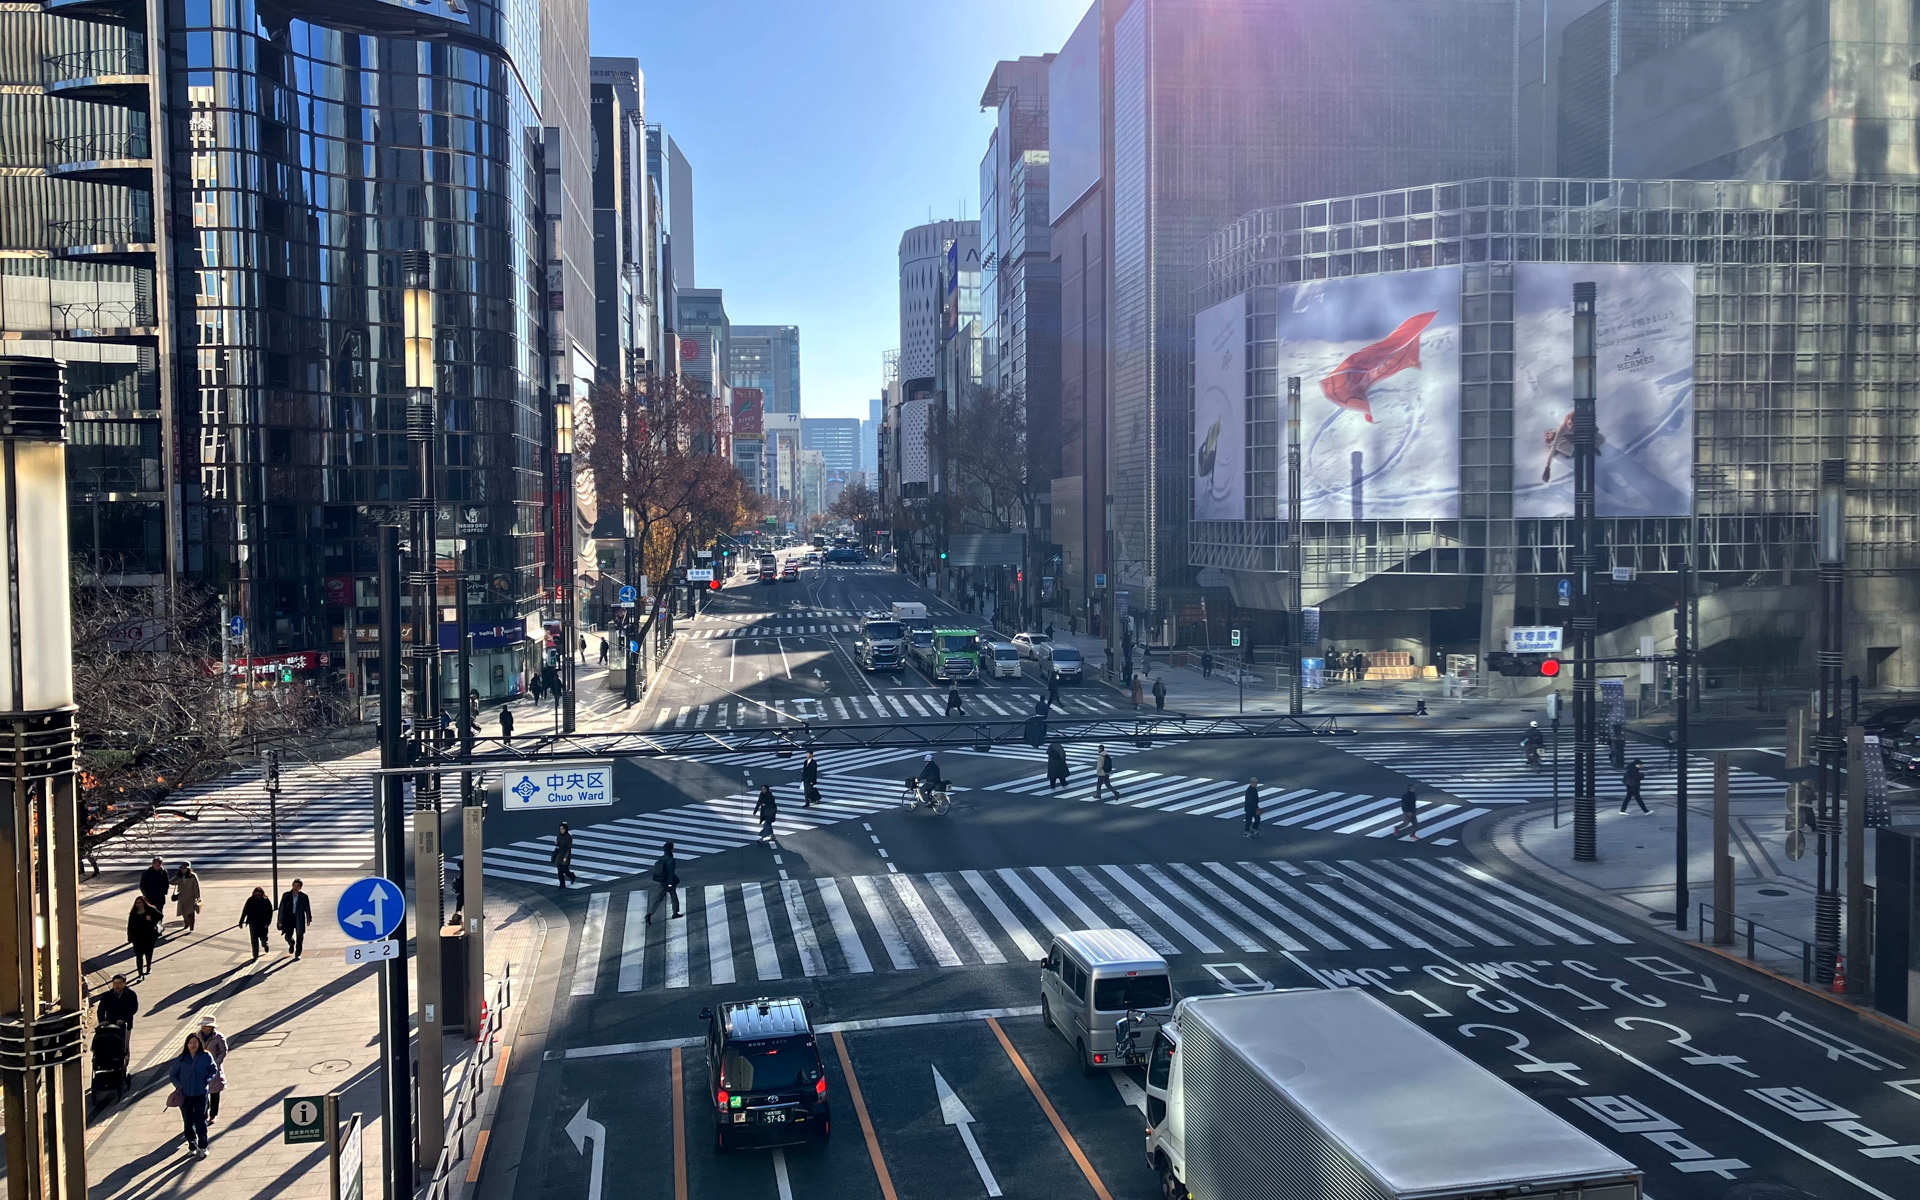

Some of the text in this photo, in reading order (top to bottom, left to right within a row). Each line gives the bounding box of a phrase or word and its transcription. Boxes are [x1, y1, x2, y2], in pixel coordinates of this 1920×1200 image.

[546, 772, 605, 791] 中央区
[547, 790, 604, 802] Chuo Ward
